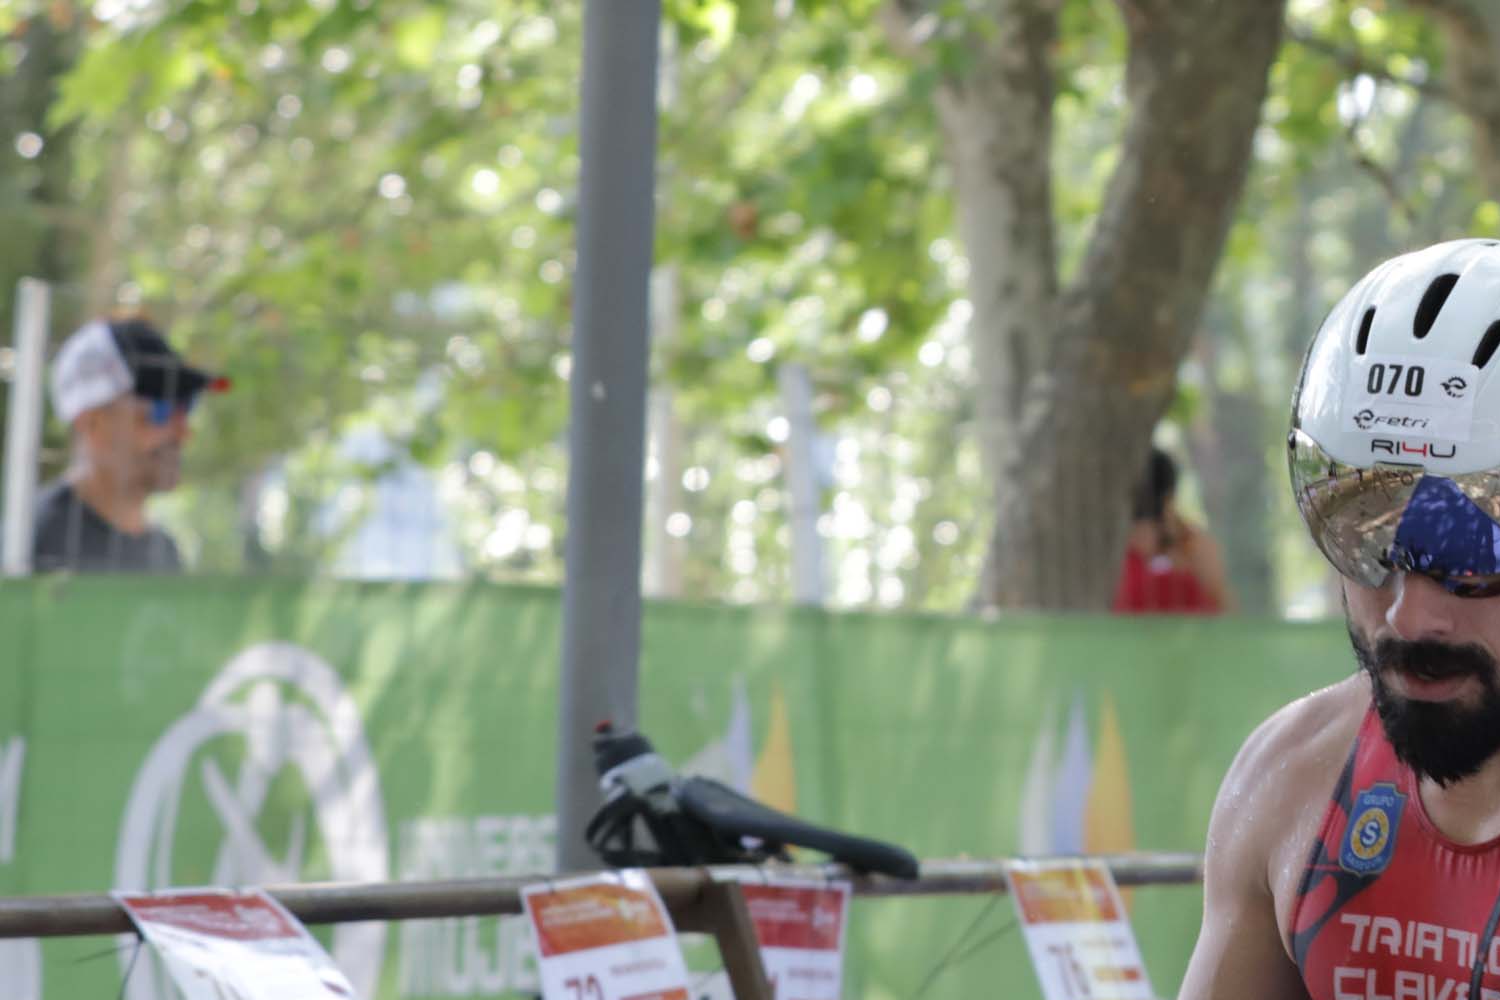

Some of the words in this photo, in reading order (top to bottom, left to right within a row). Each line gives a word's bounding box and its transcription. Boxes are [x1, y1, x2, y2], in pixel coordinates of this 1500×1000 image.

[1367, 363, 1426, 397] 070
[1371, 438, 1456, 459] RI4U
[1361, 820, 1379, 846] S
